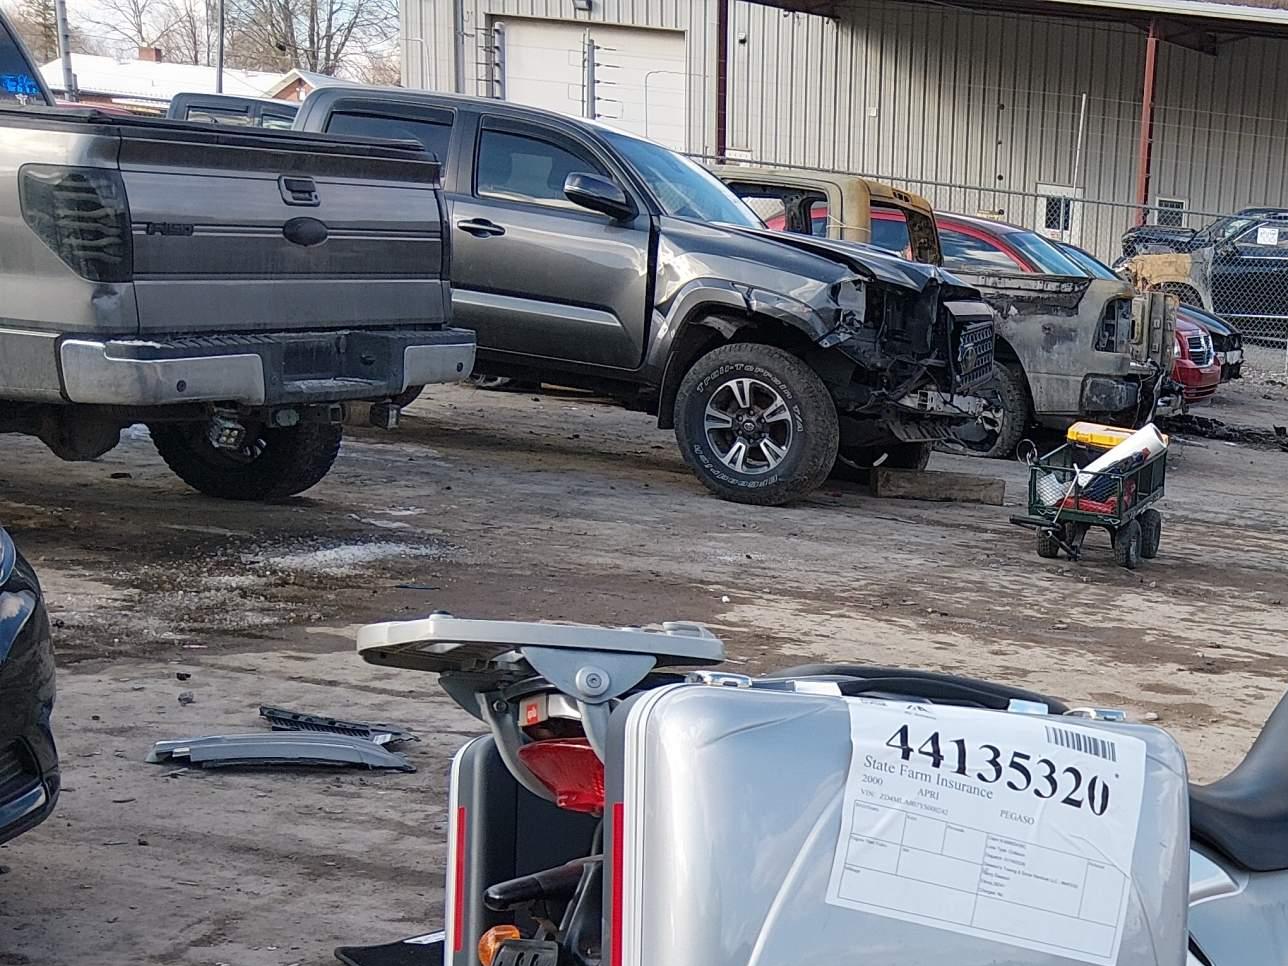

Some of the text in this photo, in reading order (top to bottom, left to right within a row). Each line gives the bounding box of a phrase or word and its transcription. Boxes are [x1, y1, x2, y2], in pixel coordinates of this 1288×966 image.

[863, 754, 993, 800] State Farm Insurance
[885, 724, 1110, 816] 44135320
[862, 774, 884, 787] 2000
[917, 788, 940, 801] APRI
[999, 809, 1035, 825] PEGASO
